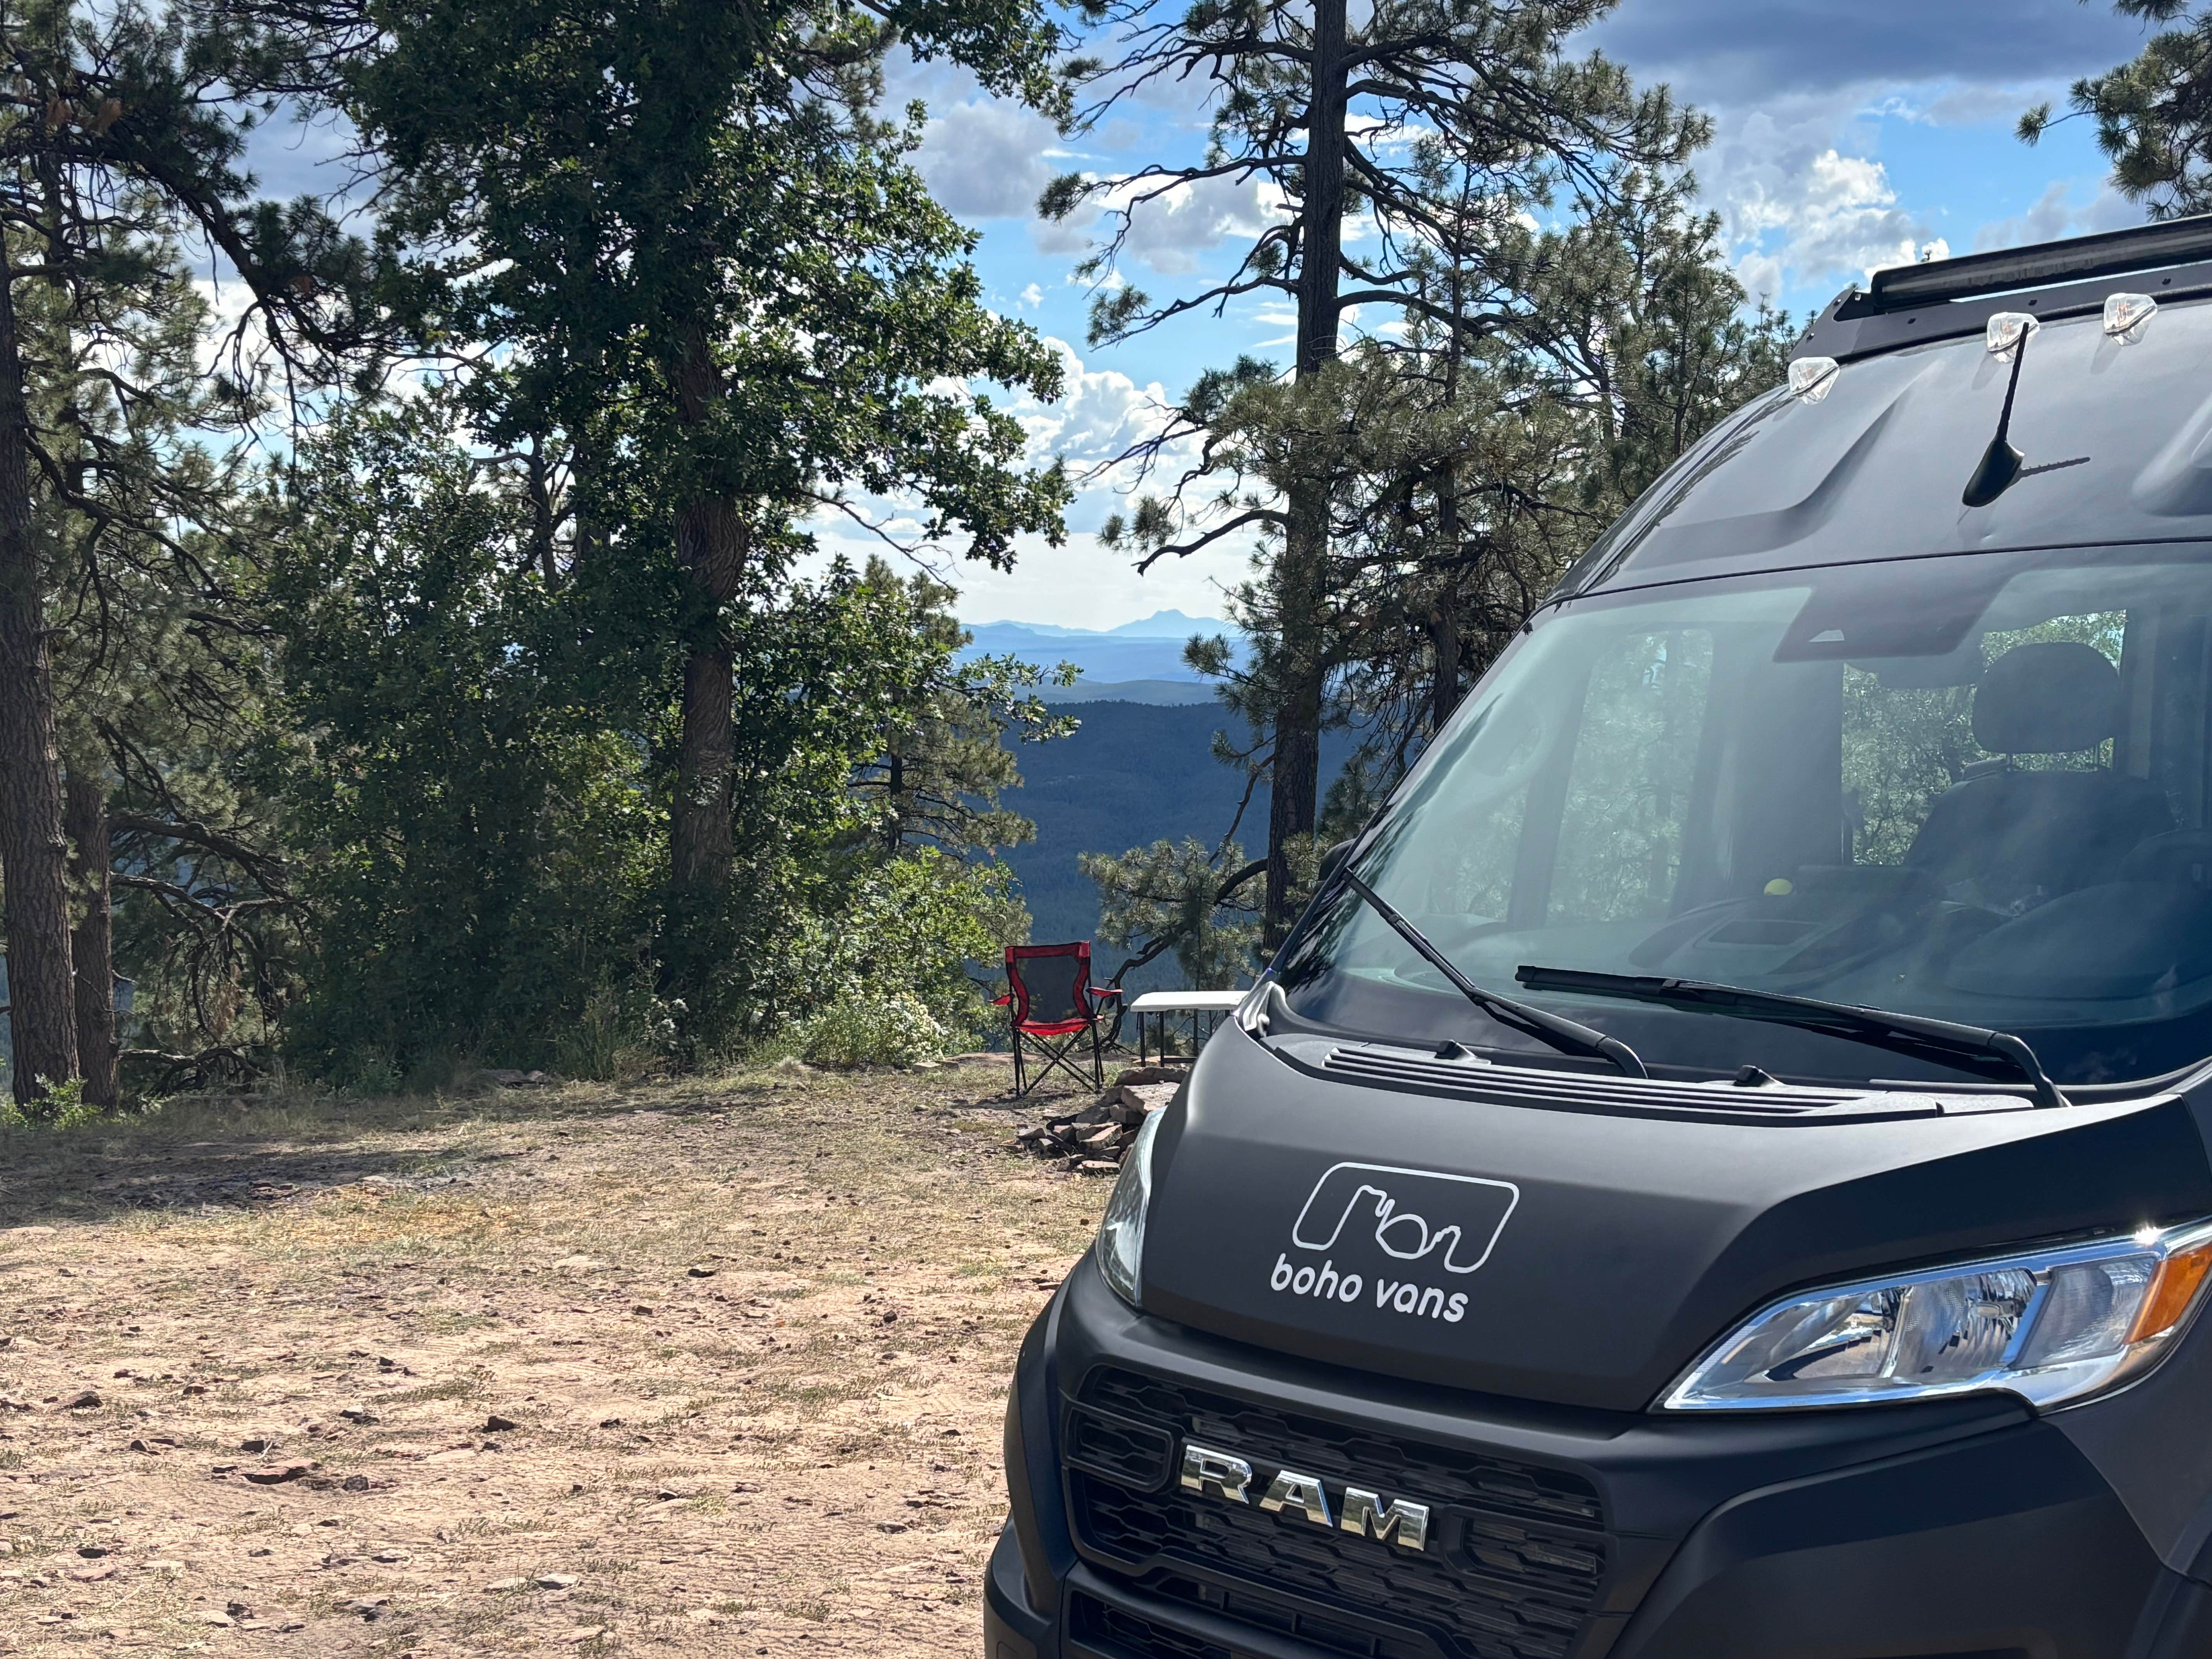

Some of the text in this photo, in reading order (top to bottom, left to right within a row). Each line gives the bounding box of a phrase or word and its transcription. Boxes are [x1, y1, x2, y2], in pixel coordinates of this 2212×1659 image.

[1271, 1253, 1468, 1322] boho vans
[1181, 1444, 1429, 1551] RAM
